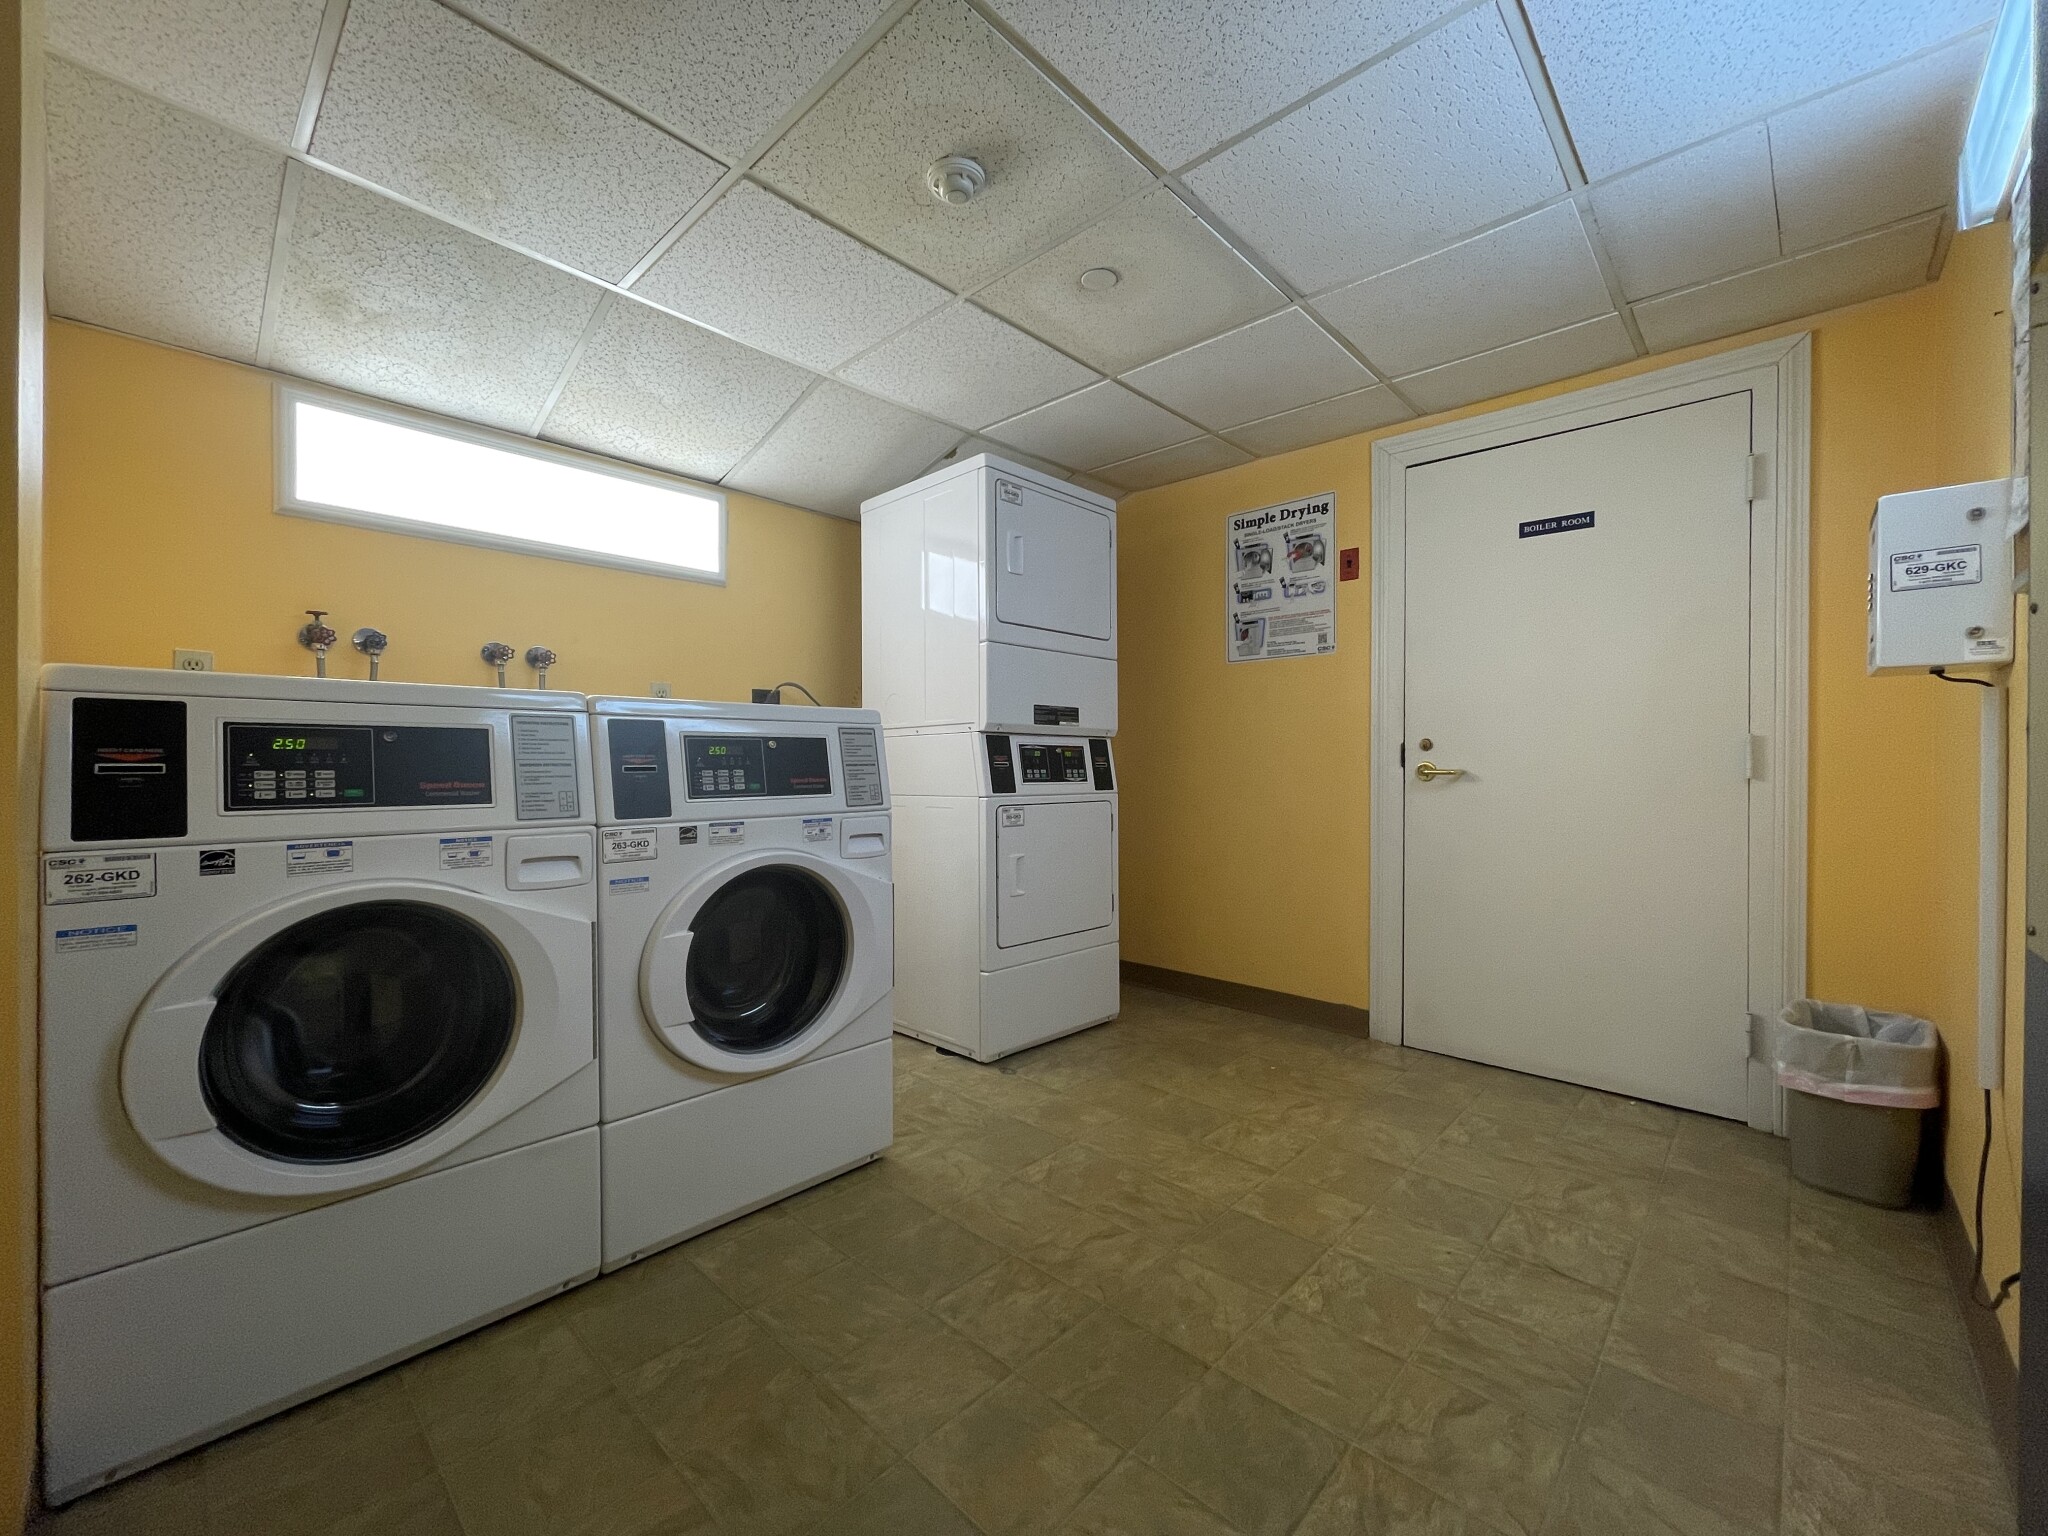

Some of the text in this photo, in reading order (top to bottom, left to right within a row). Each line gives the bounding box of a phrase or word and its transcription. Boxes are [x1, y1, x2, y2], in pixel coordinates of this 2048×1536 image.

[1234, 513, 1276, 530] Simple
[1280, 502, 1329, 521] Drying
[1524, 516, 1590, 533] BOILER ROOM
[1905, 560, 1967, 576] 629-GKC
[611, 840, 650, 850] 263-GKD
[48, 859, 77, 867] CSC
[63, 870, 141, 885] 262-GKD
[68, 926, 128, 936] NOTICE
